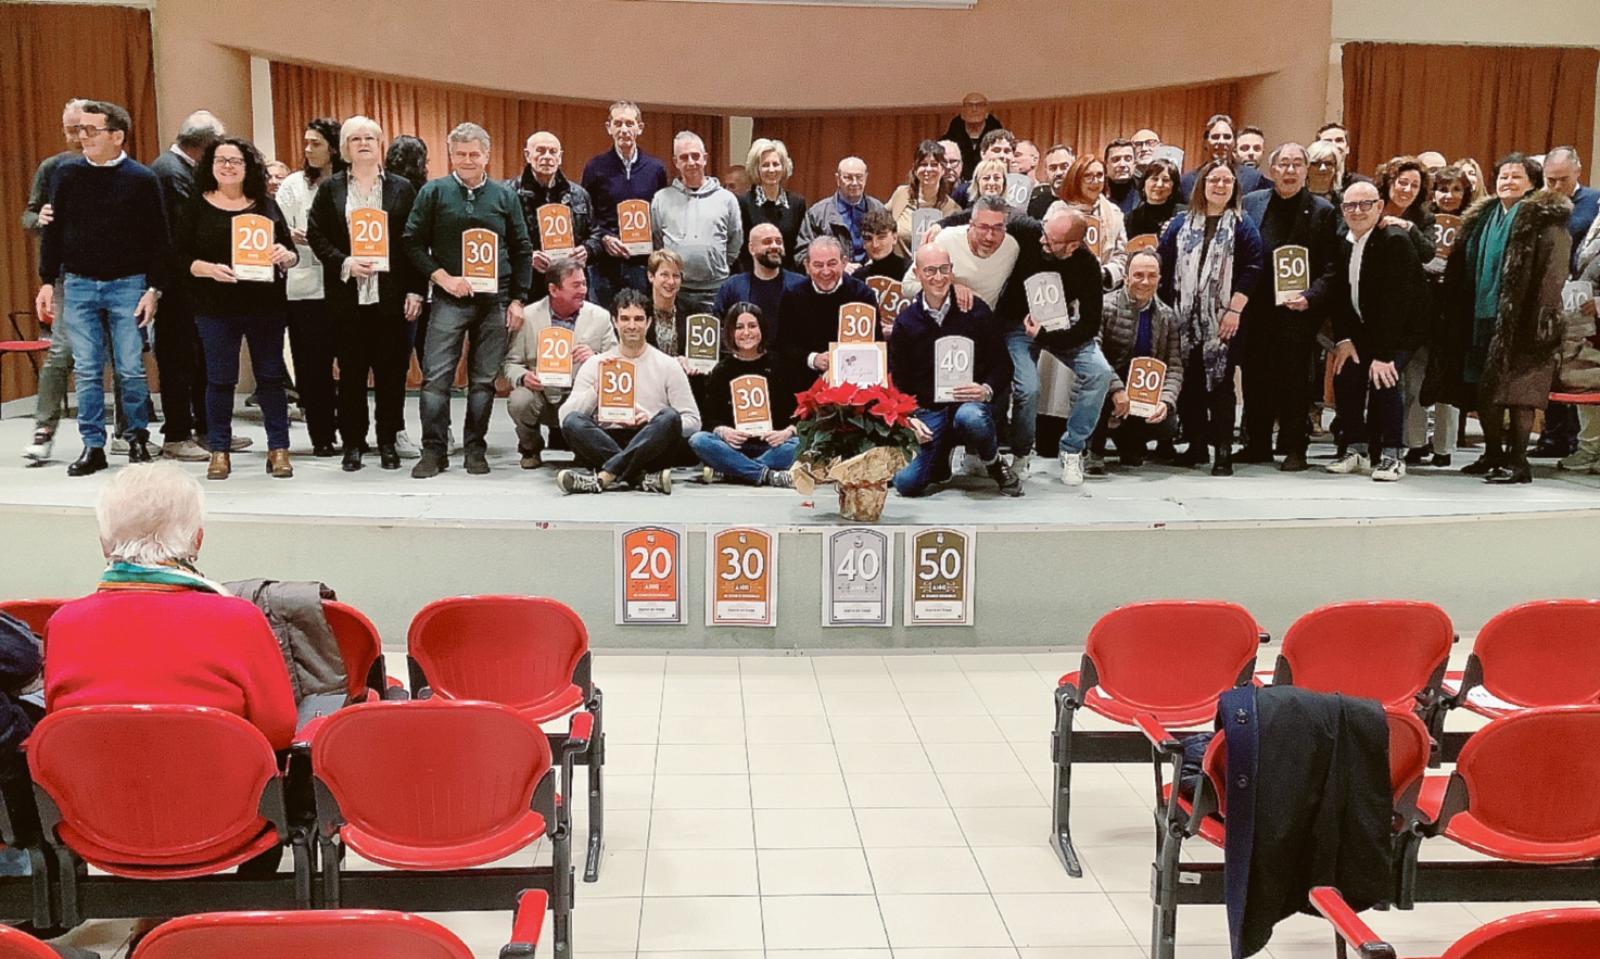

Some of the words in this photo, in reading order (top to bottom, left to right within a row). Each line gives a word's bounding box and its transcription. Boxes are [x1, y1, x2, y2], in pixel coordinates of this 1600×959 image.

[354, 220, 383, 242] 20
[543, 215, 568, 237] 20
[622, 210, 647, 231] 20
[238, 227, 268, 250] 20
[1433, 223, 1456, 247] 30
[466, 241, 494, 264] 30
[1279, 256, 1306, 278] 50
[1033, 284, 1060, 307] 40
[690, 325, 716, 347] 50
[842, 314, 872, 337] 30
[541, 337, 569, 360] 20
[940, 350, 969, 372] 40
[603, 371, 633, 394] 30
[1131, 367, 1161, 391] 30
[736, 386, 765, 410] 30
[630, 546, 673, 580] 20
[720, 547, 764, 581] 30
[836, 548, 880, 581] 40
[918, 548, 962, 581] 50
